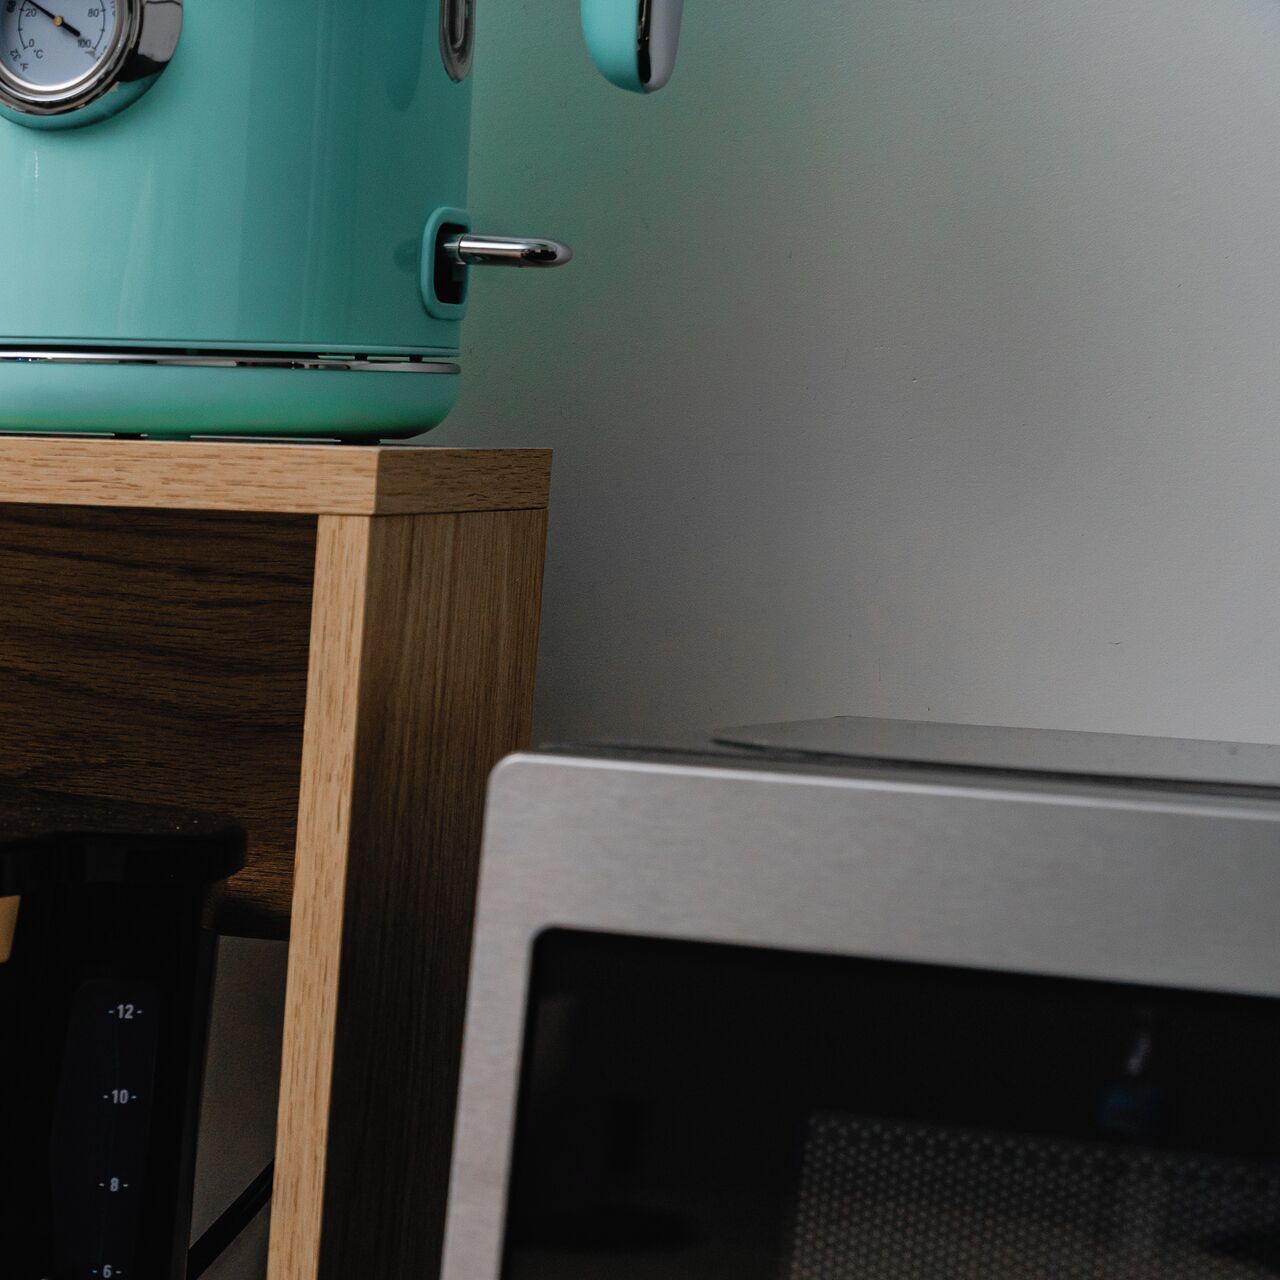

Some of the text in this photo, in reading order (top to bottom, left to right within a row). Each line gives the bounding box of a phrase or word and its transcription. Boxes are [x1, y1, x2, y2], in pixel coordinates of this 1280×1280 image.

[25, 8, 37, 17] 20
[87, 8, 100, 18] 80
[28, 38, 35, 48] 0
